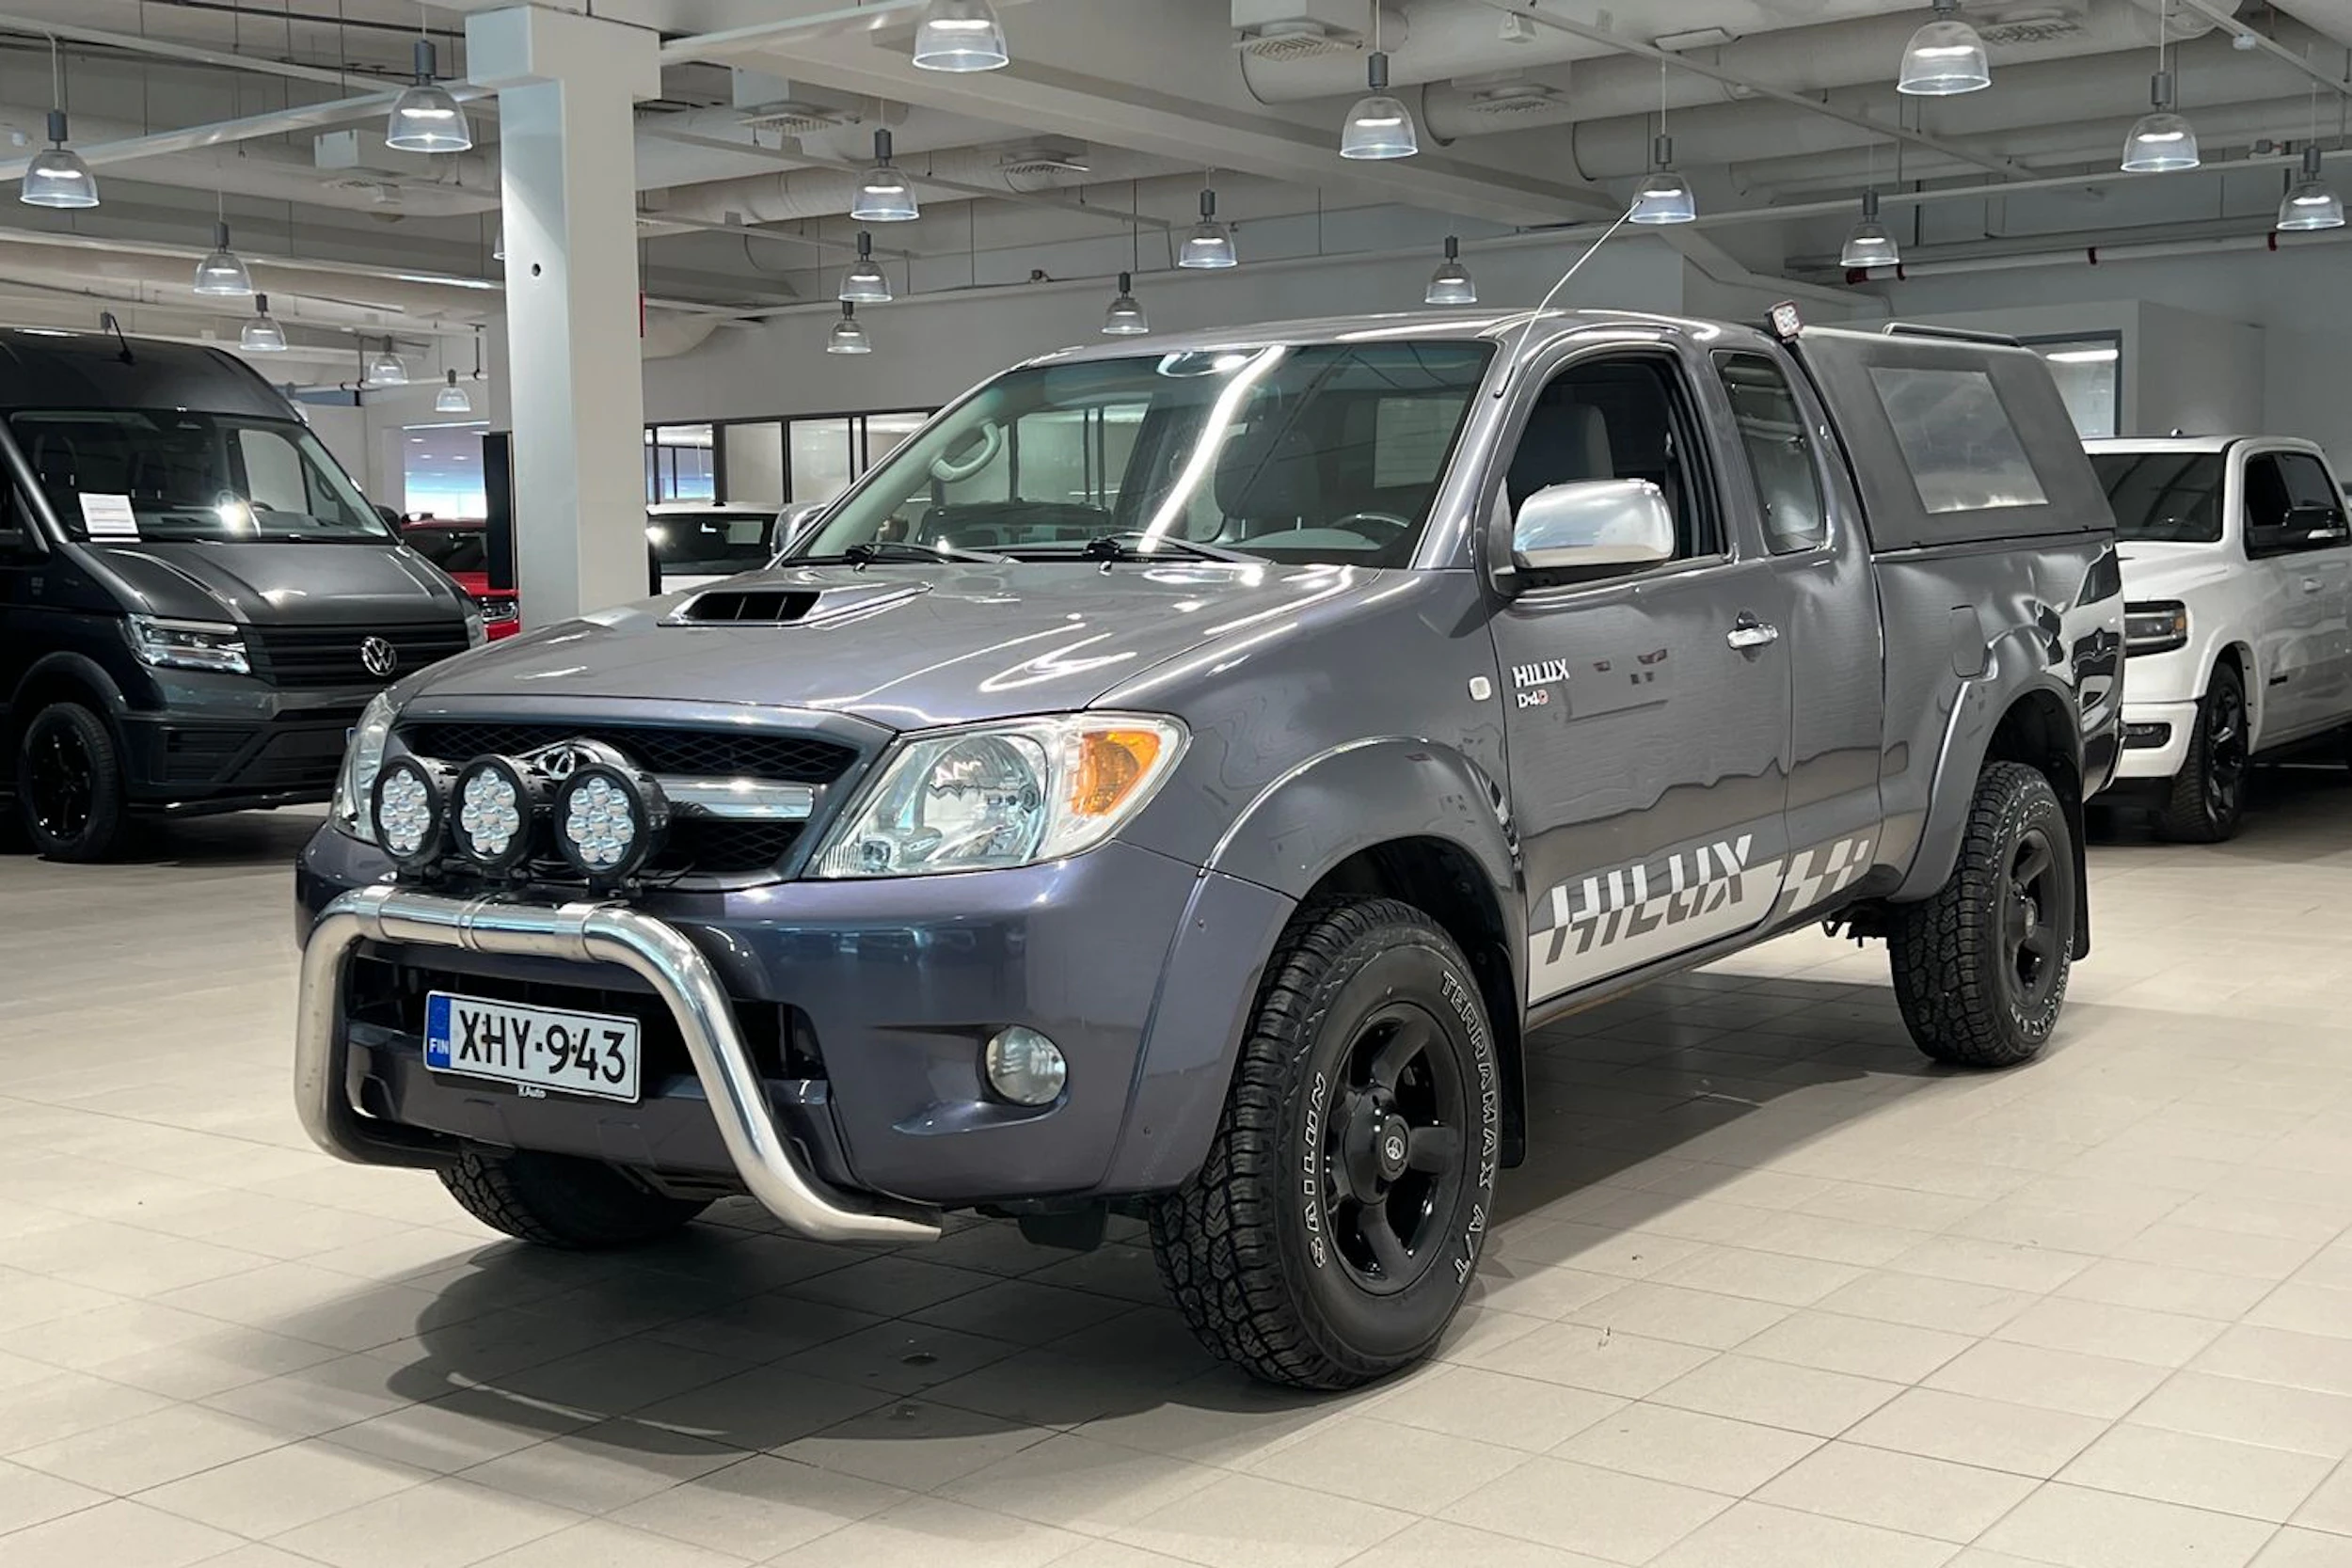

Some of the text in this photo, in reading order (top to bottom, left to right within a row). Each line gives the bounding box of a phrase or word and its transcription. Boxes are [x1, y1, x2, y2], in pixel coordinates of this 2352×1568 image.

[1512, 657, 1570, 688] HILUX
[1546, 833, 1753, 964] HILUX
[429, 1037, 450, 1054] FIN
[459, 1009, 626, 1084] XHY-943
[1304, 1072, 1327, 1268] SAILUN
[1442, 971, 1498, 1284] TERRAMAX A/T
